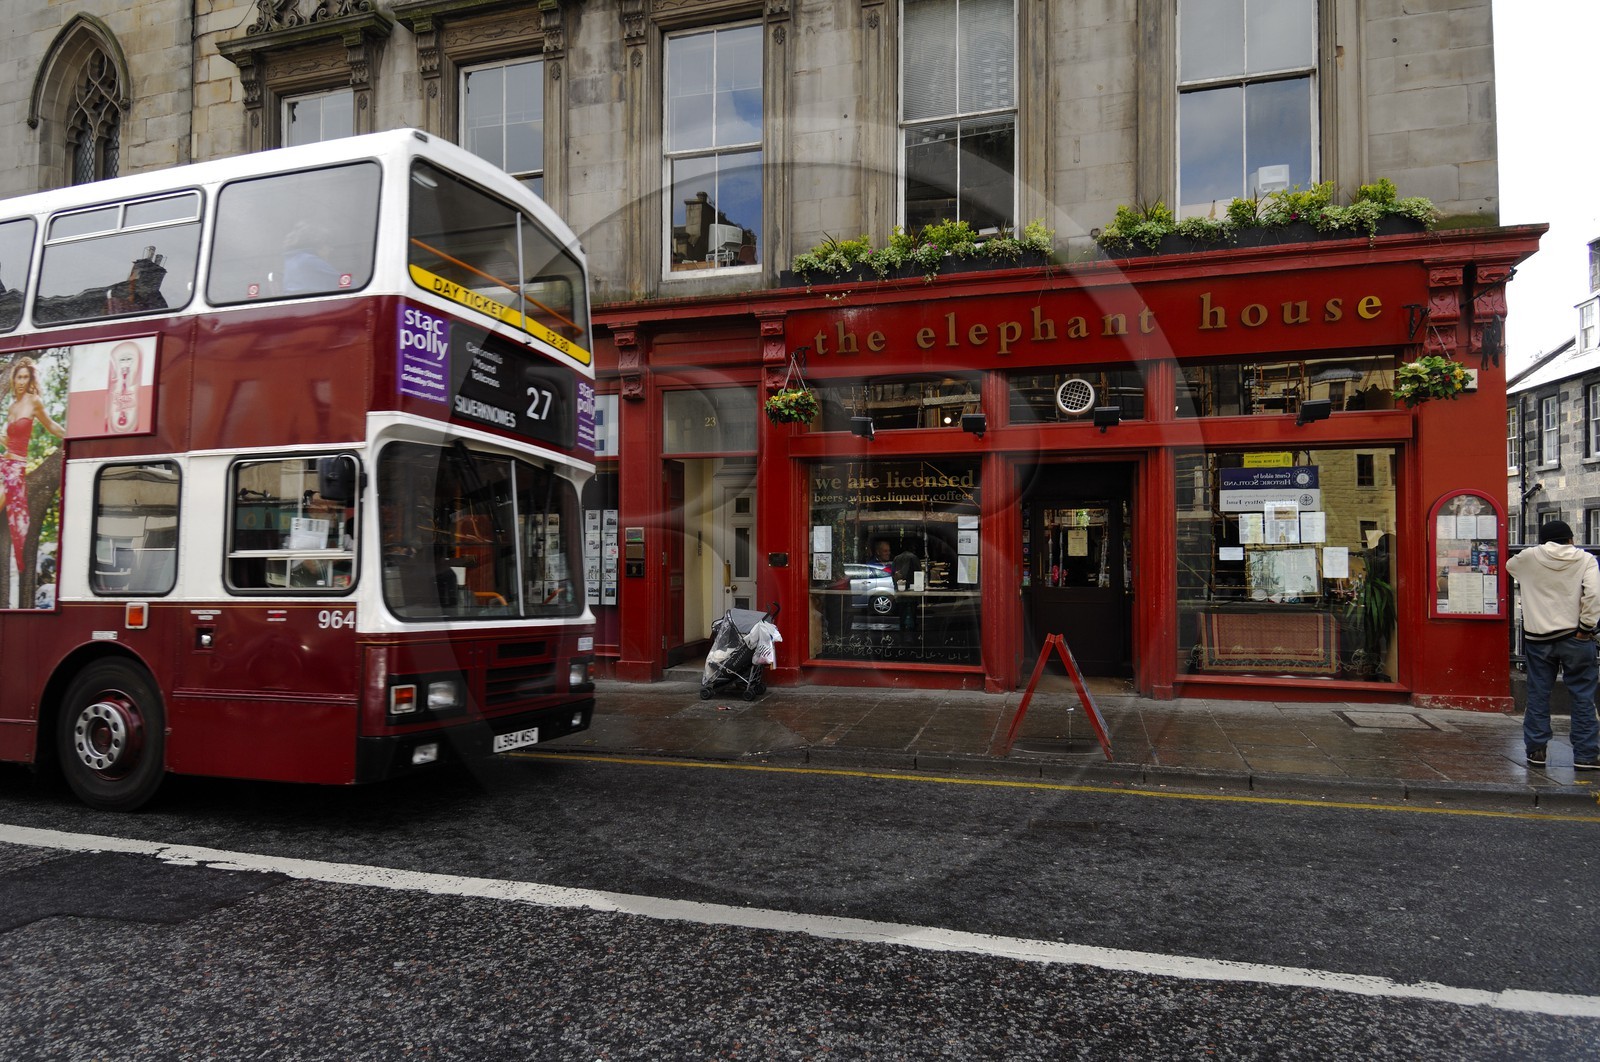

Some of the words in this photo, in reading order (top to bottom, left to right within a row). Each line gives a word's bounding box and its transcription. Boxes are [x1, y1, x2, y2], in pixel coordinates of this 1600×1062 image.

[433, 278, 458, 298] DAY
[462, 291, 504, 315] TICKET
[404, 309, 444, 335] stac
[814, 320, 886, 355] the
[916, 302, 1155, 356] elephant
[1198, 292, 1383, 330] house
[399, 328, 449, 361] polly
[454, 394, 517, 428] SILVERKNOWES
[526, 386, 552, 421] 27
[704, 416, 716, 427] 23
[815, 477, 842, 490] we
[847, 474, 880, 489] are
[886, 469, 975, 489] licensed
[814, 492, 844, 503] beers
[849, 492, 881, 504] wines
[887, 491, 930, 505] liqueur
[932, 490, 974, 502] coffees
[318, 610, 355, 629] 964
